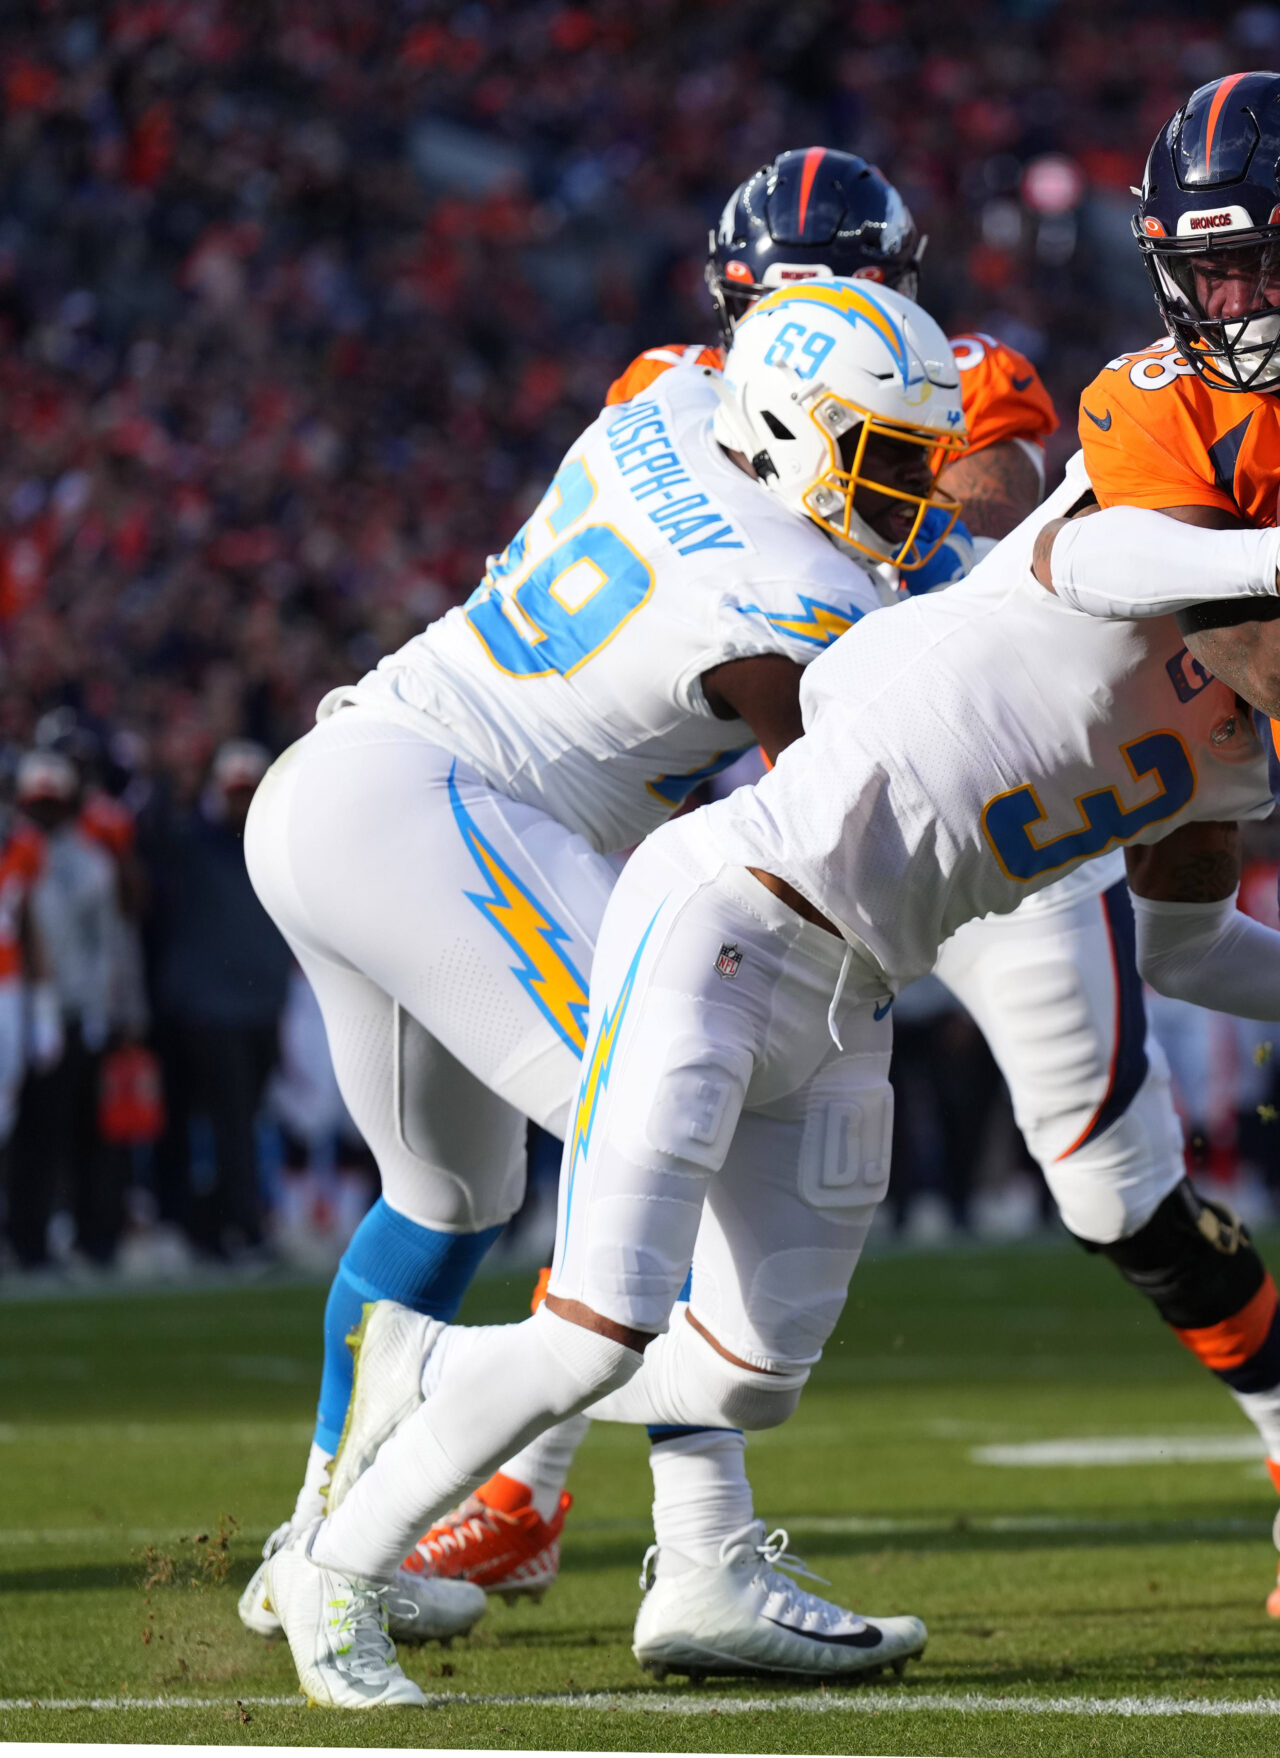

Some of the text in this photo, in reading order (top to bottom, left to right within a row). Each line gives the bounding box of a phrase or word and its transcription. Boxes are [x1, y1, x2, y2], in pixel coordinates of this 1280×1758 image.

[1190, 213, 1232, 230] BRONCOS
[764, 322, 836, 380] 69
[980, 728, 1198, 883] 3
